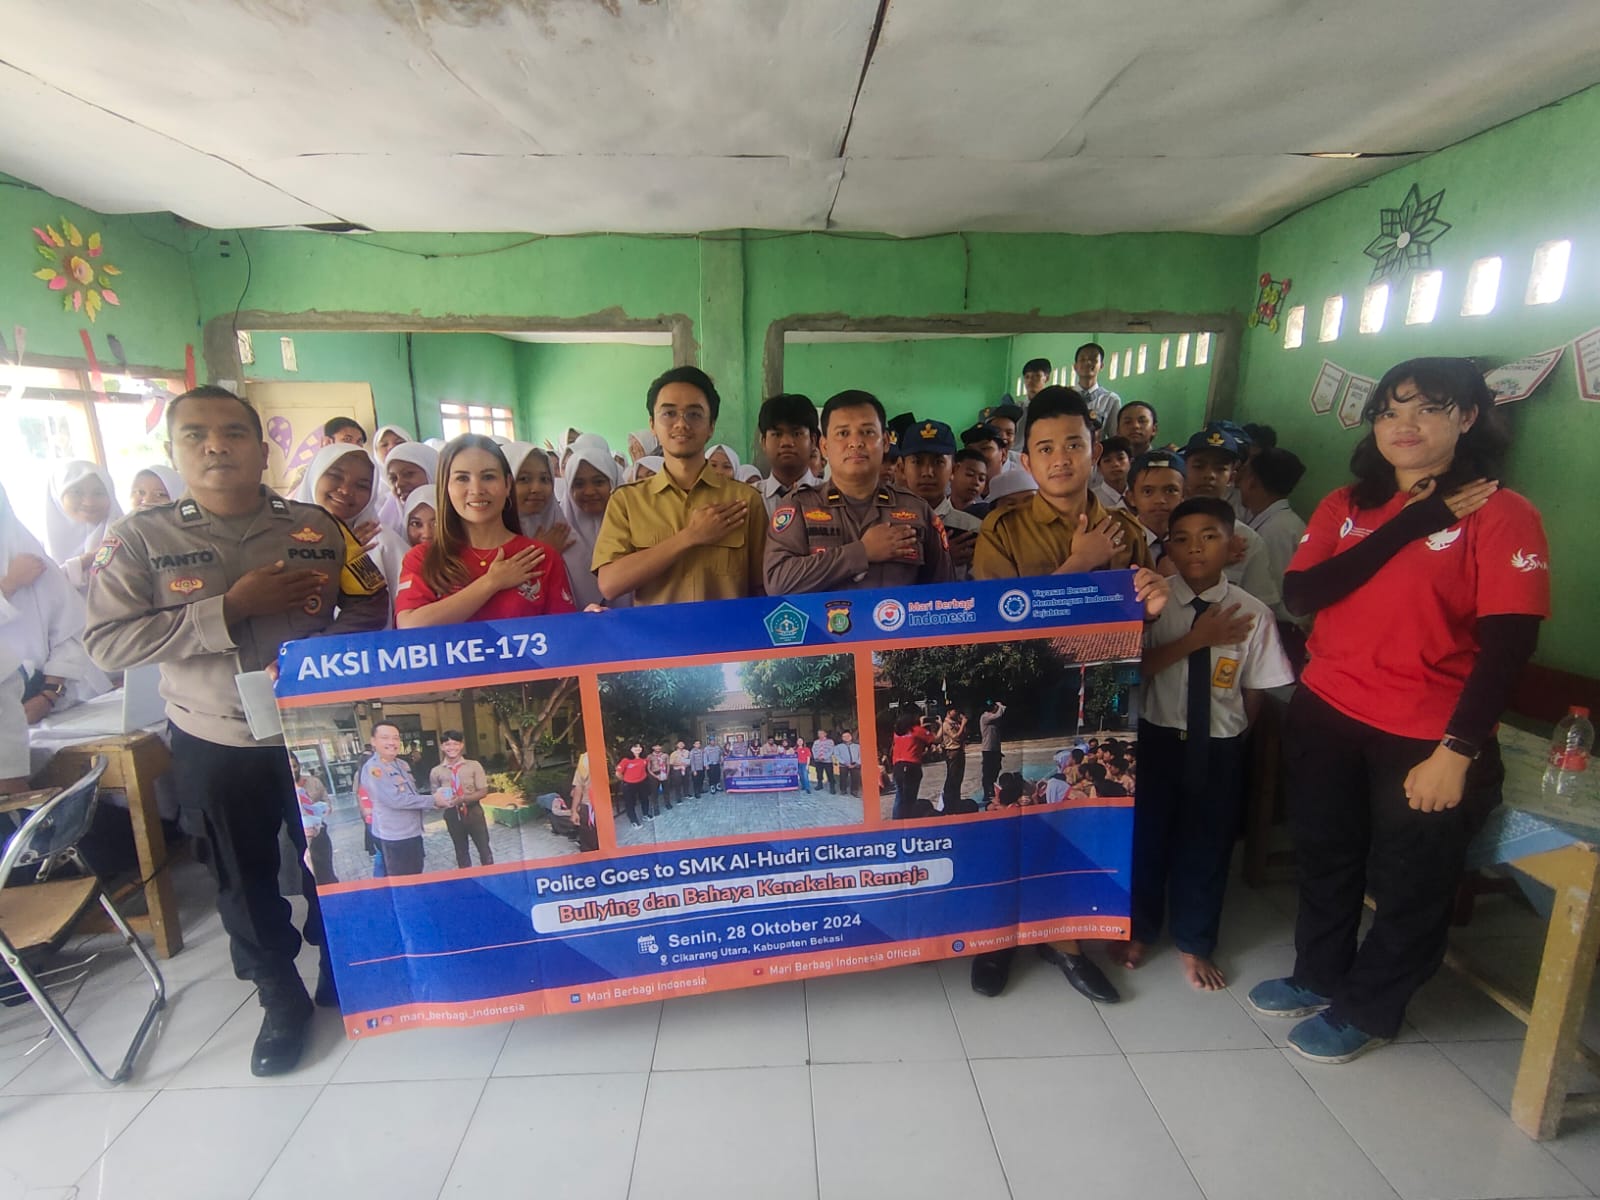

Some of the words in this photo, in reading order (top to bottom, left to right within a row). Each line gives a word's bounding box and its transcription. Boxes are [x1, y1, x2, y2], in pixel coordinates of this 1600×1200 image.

[150, 551, 213, 569] YANTO
[288, 548, 336, 560] POLRI
[908, 601, 933, 613] Mari
[935, 597, 975, 610] Berbagi
[908, 611, 976, 626] Indonesia
[297, 651, 370, 680] AKSI
[378, 643, 438, 672] MBI
[446, 632, 548, 665] KE-173
[536, 875, 597, 895] Police
[601, 867, 650, 886] Goes
[654, 863, 675, 878] to
[679, 855, 726, 876] SMK
[730, 846, 811, 870] Al-Hudri
[815, 841, 897, 861] Cikarang
[901, 837, 952, 854] Utara
[558, 899, 640, 923] Bullying
[643, 892, 680, 911] dan
[683, 883, 753, 905] Bahaya
[757, 873, 856, 896] Kenakalan
[860, 865, 929, 887] Remaja
[668, 930, 722, 948] Senin,
[727, 925, 746, 940] 28
[751, 919, 818, 937] Oktober
[823, 914, 862, 929] 2024
[672, 949, 718, 963] Cikarang
[720, 945, 751, 957] Utara,
[753, 938, 808, 952] Kabupaten
[811, 934, 844, 945] Bekasi
[769, 965, 792, 975] Mari
[795, 959, 834, 971] Berbagi
[836, 953, 884, 966] Indonesia
[887, 948, 921, 960] Official
[586, 989, 611, 1002] Mari
[614, 983, 655, 998] Berbagi
[657, 976, 707, 991] Indonesia
